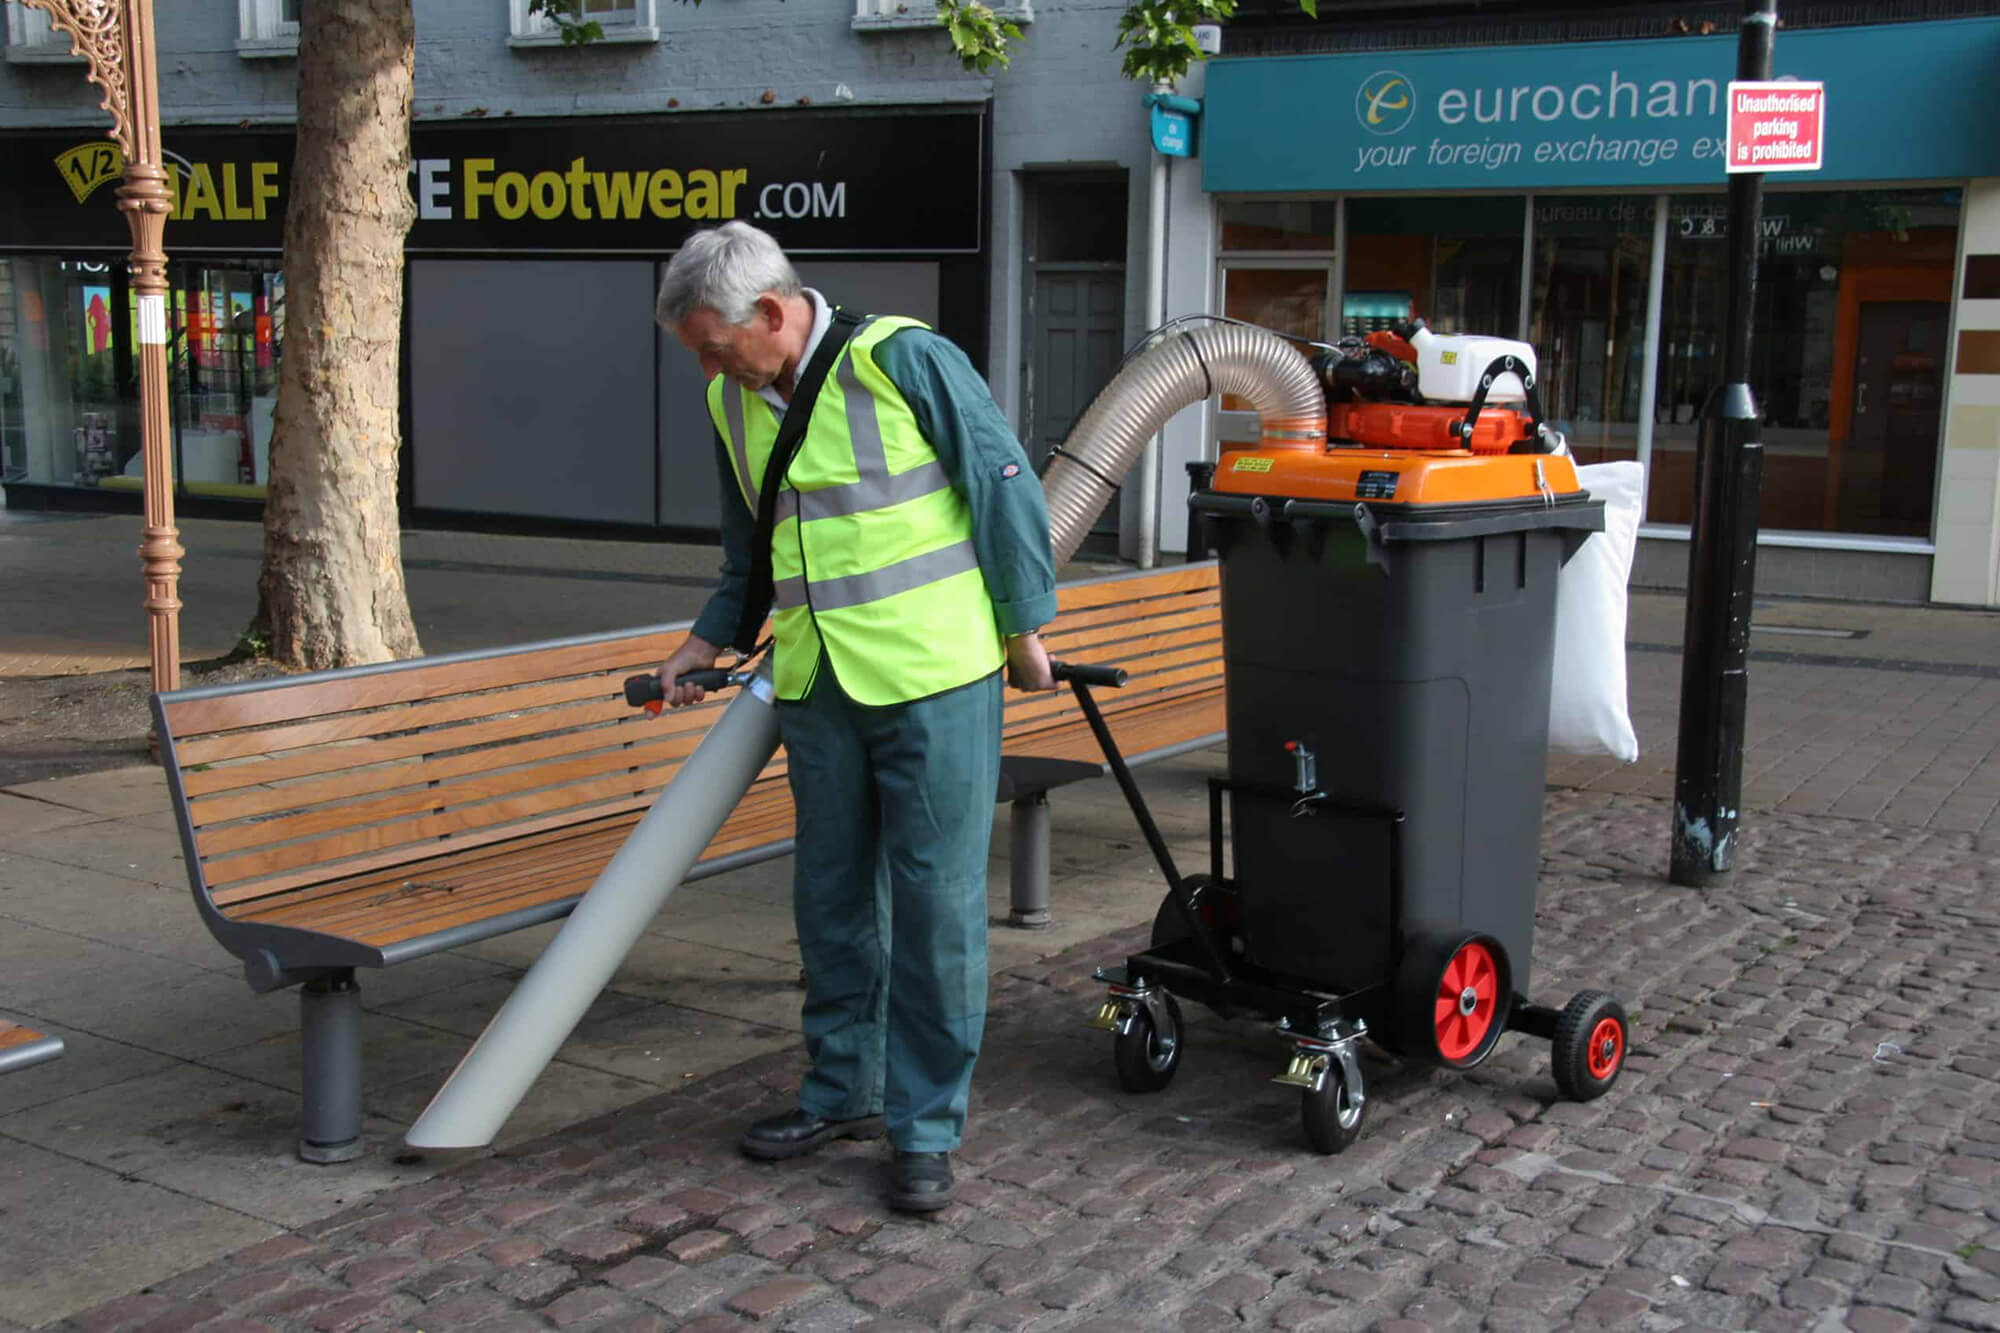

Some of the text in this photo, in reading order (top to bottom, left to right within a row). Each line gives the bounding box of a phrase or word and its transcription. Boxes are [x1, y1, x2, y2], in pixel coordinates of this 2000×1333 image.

[1437, 69, 1799, 125] eurochan
[1737, 92, 1817, 113] Unauthorised
[1752, 117, 1798, 139] parking
[71, 149, 116, 185] 1/2
[1354, 142, 1416, 173] your
[1427, 136, 1522, 169] foreign
[1534, 134, 1678, 165] exchange
[1737, 141, 1749, 161] is
[1752, 140, 1812, 164] prohibited
[462, 156, 747, 220] Footwear
[753, 181, 846, 219] .COM
